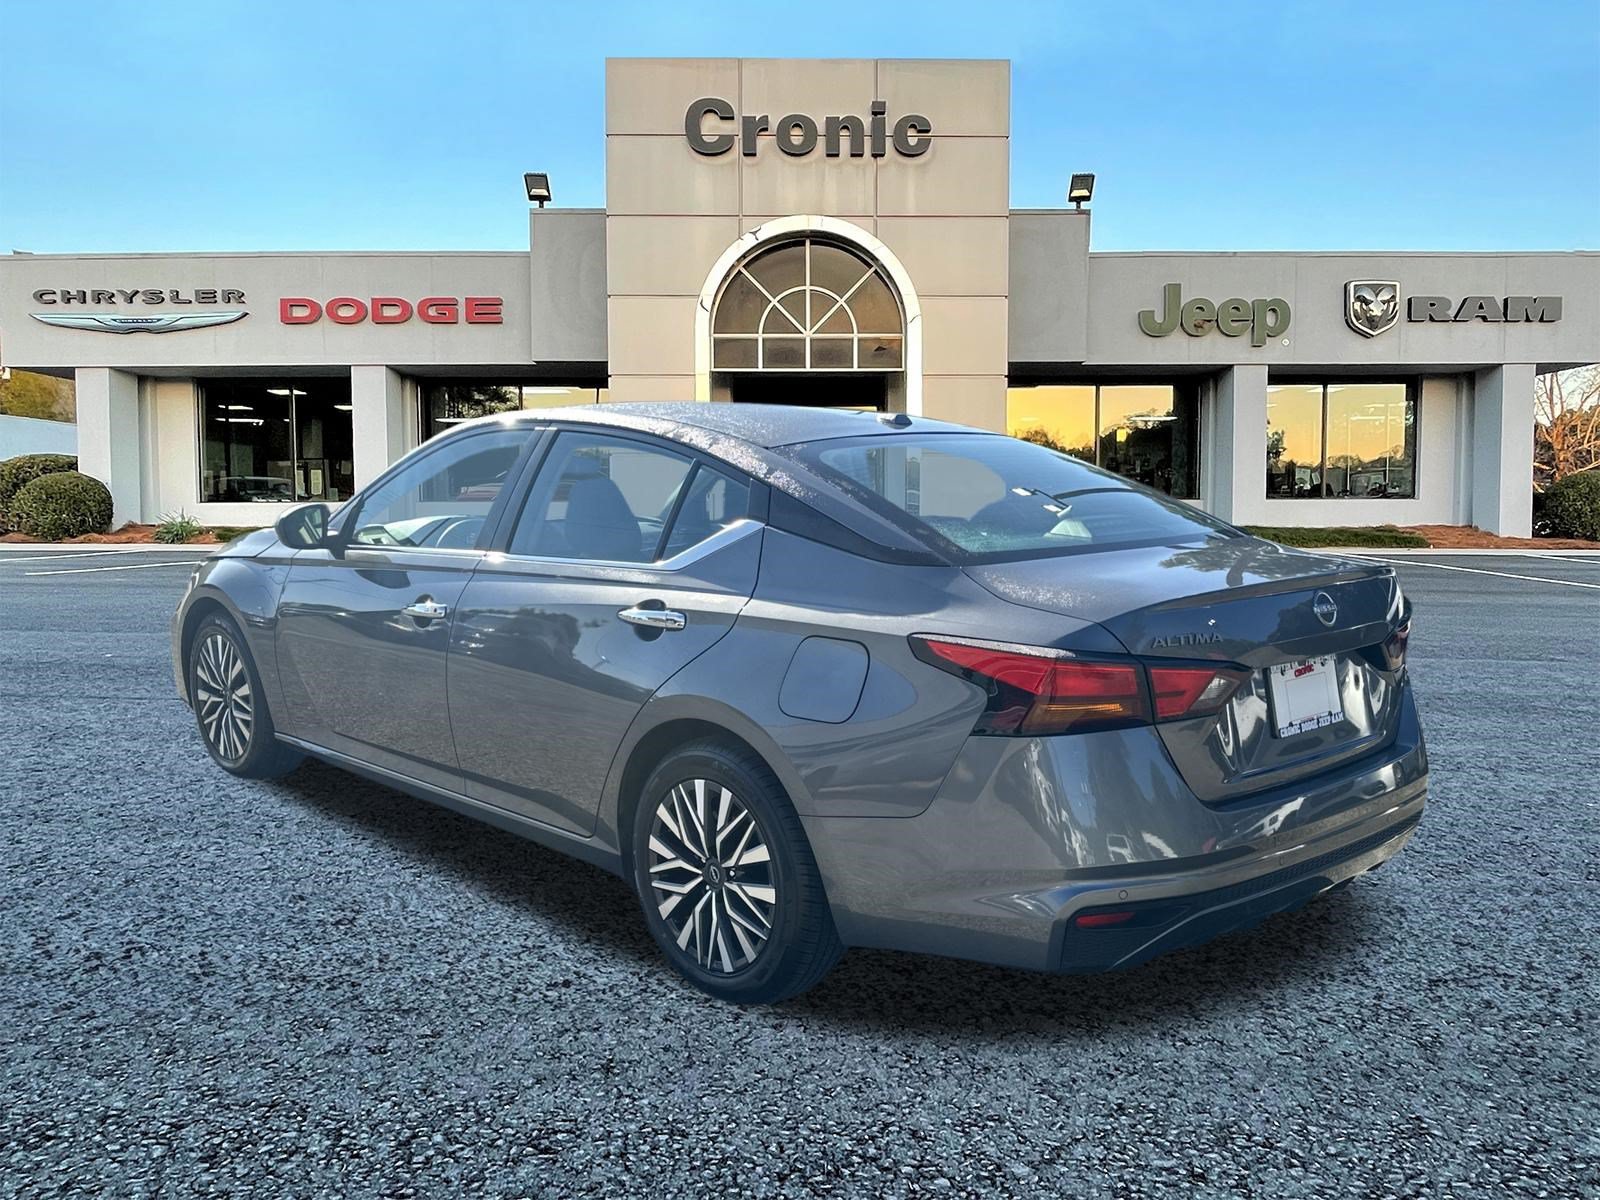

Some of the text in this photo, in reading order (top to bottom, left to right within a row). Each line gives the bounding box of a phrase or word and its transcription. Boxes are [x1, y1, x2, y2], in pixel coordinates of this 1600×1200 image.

[685, 97, 932, 157] Cronic
[32, 288, 248, 305] CHRYSLER
[279, 296, 504, 325] DODGE
[1406, 295, 1563, 323] RAM
[1138, 282, 1292, 347] Jeep
[1151, 631, 1224, 649] ALTIMA
